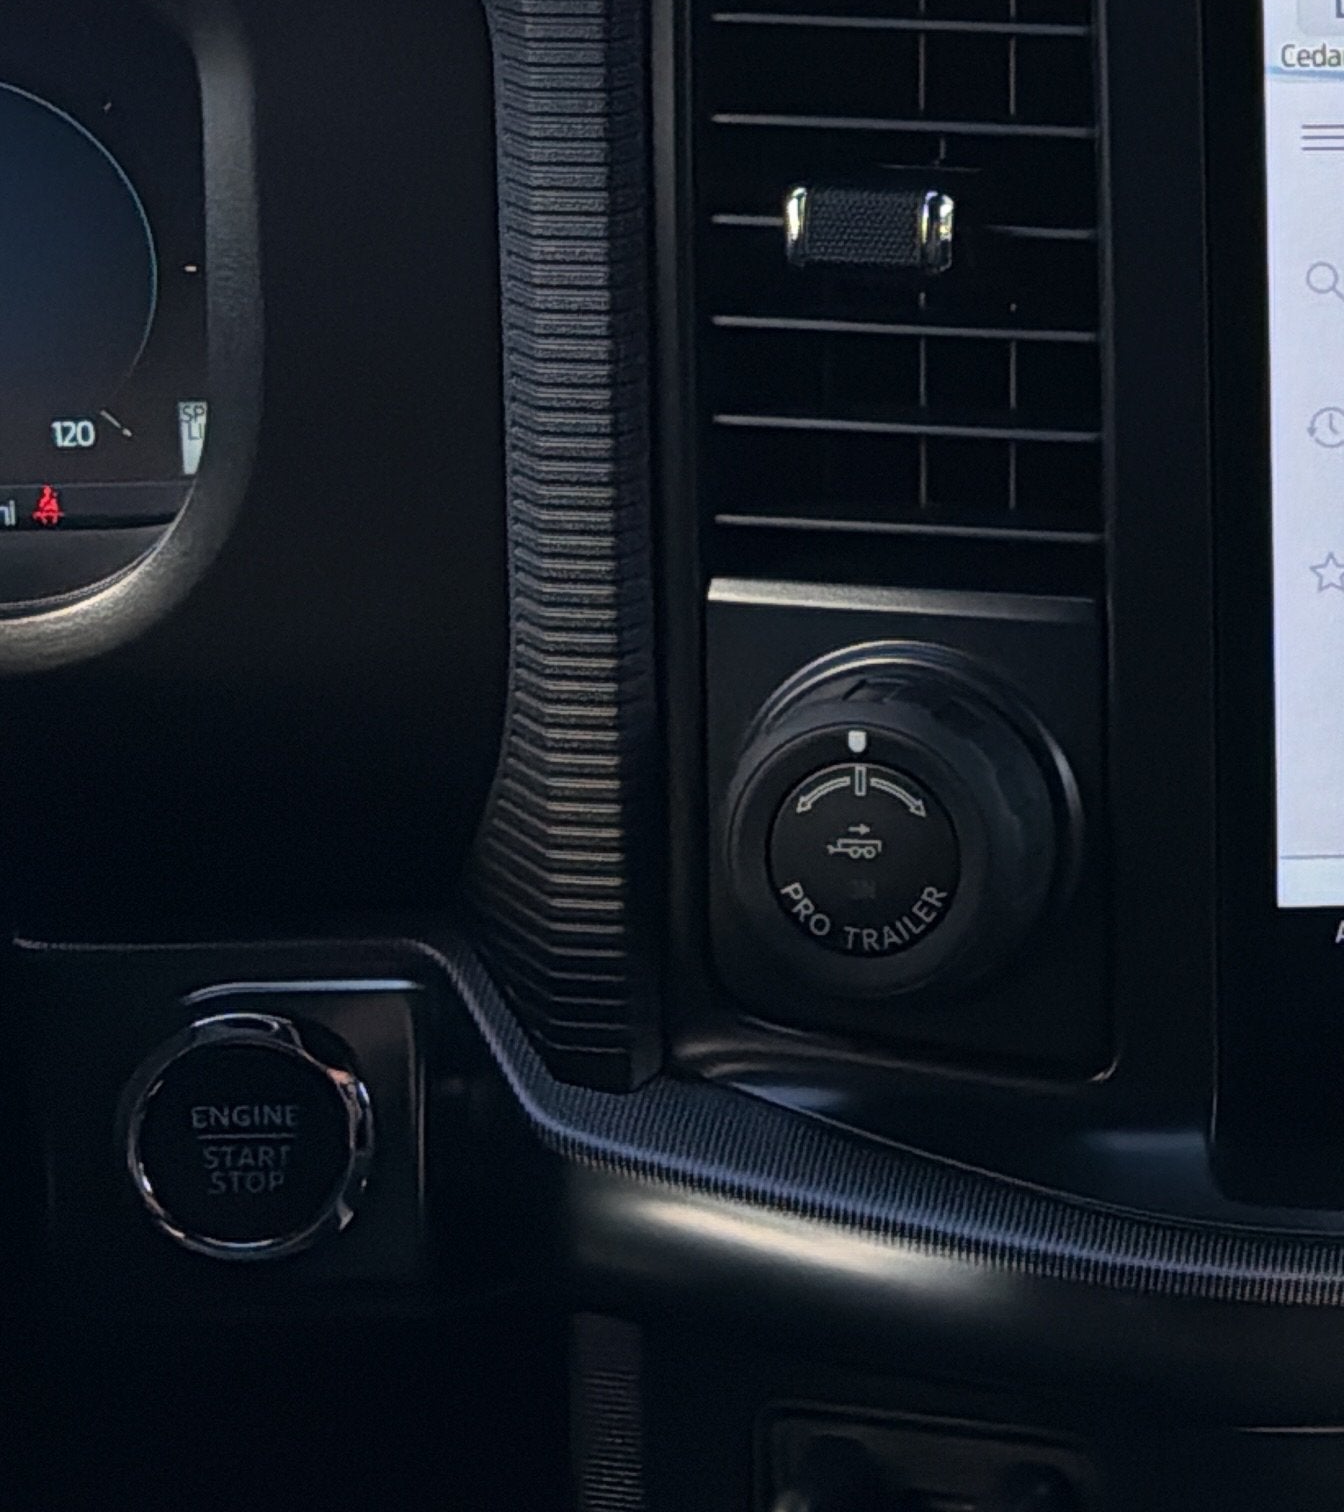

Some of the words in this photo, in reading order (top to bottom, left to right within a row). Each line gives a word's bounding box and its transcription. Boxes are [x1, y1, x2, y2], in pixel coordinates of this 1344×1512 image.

[52, 420, 95, 447] 120
[781, 881, 831, 936] PRO
[843, 885, 949, 952] TRAILER
[190, 1104, 300, 1129] ENGINE
[203, 1145, 291, 1169] START
[209, 1171, 285, 1194] STOP
